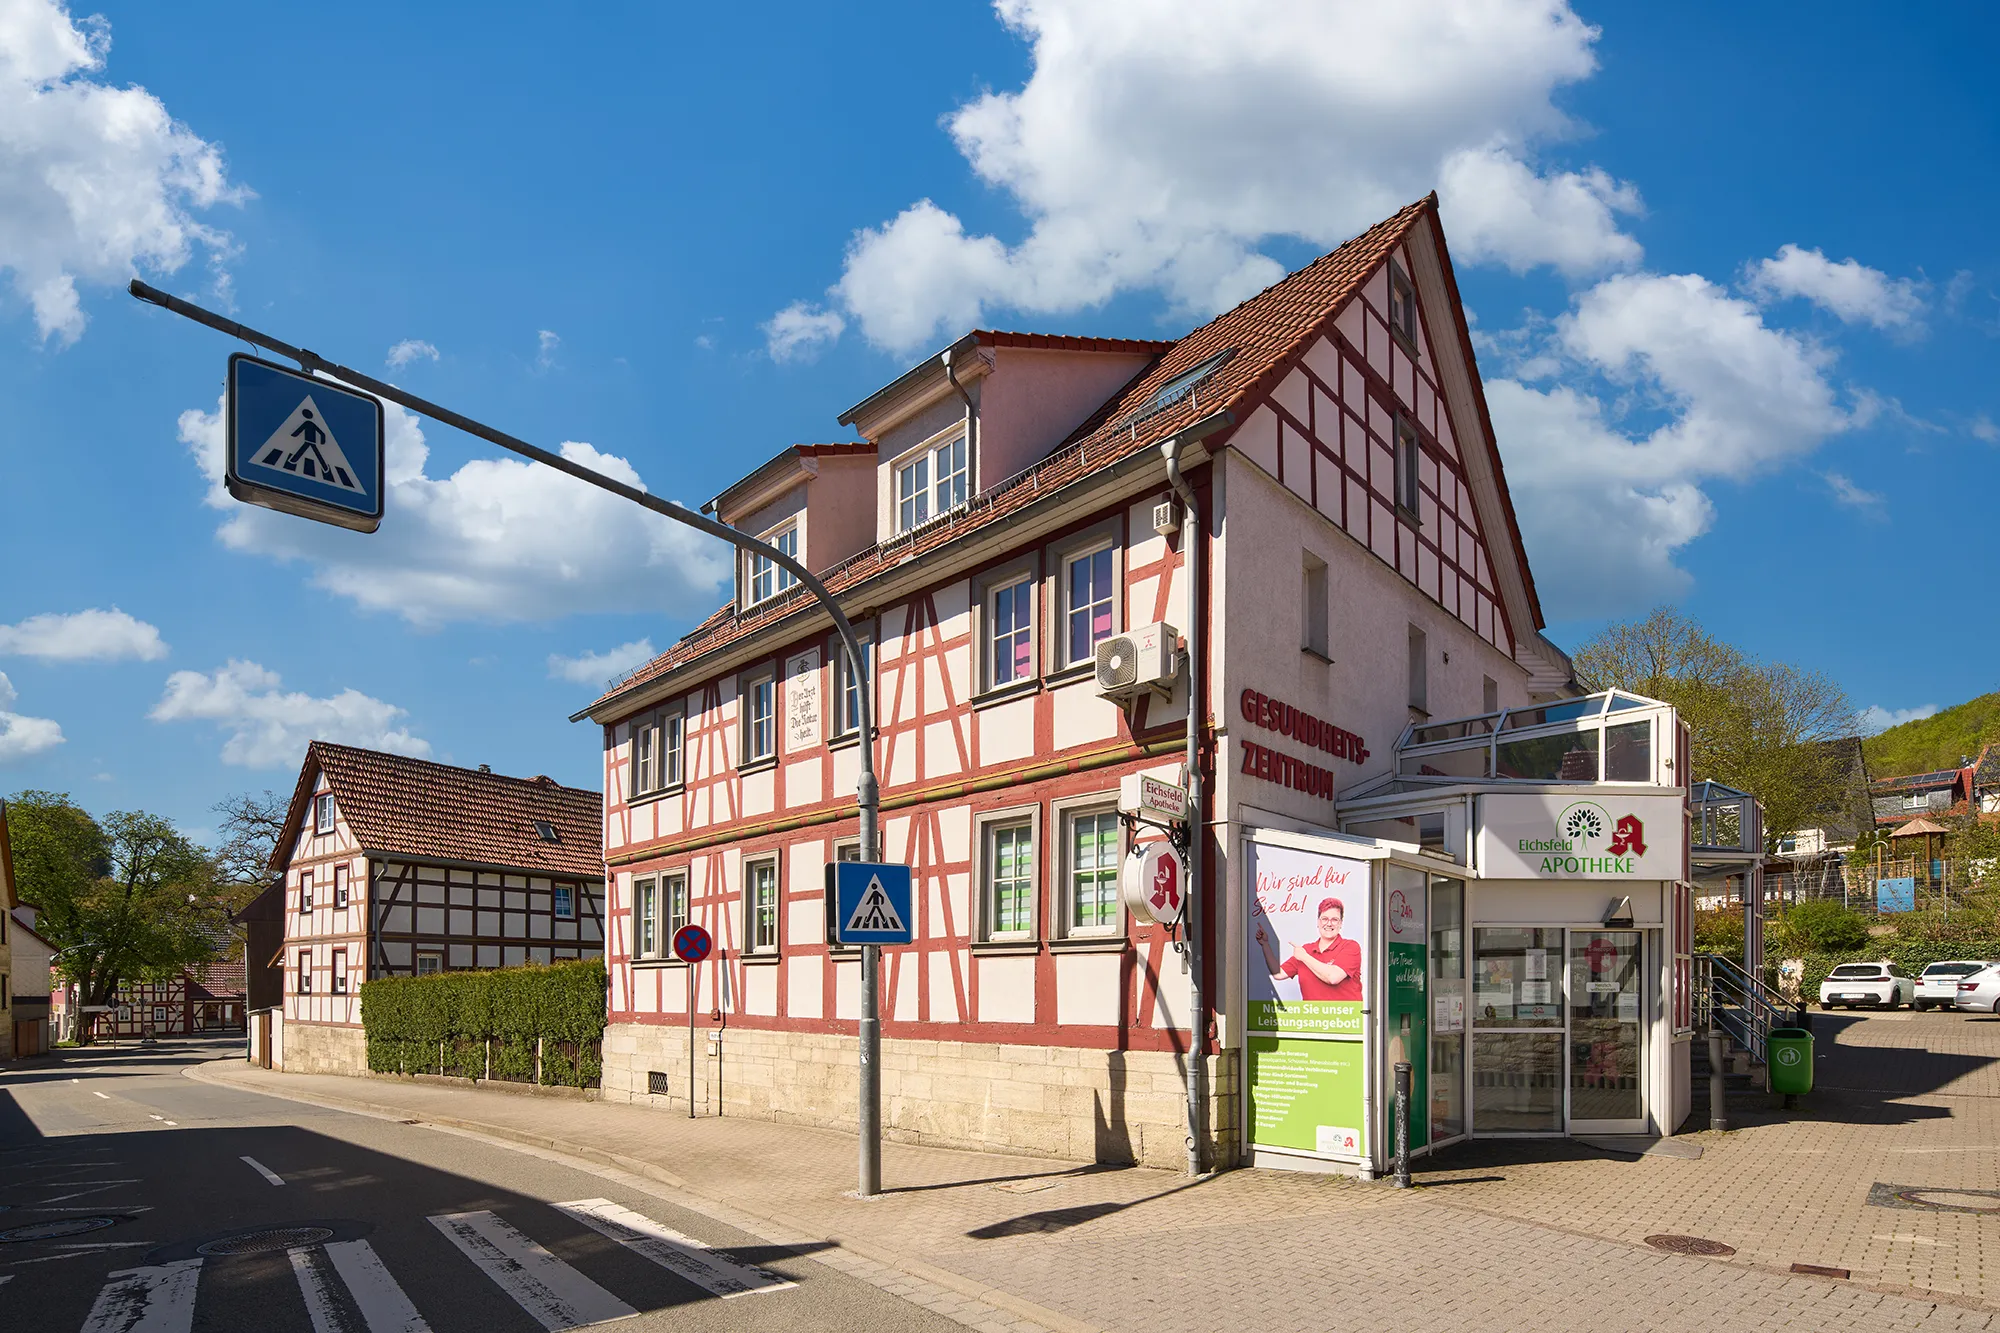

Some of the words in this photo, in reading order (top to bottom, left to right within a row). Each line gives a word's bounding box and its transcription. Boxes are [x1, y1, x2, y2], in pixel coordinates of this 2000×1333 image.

[1240, 688, 1371, 765] GESUNDHEITS-
[1240, 740, 1334, 801] ZENTRUM
[1146, 782, 1183, 803] Eichsfeld
[1150, 796, 1180, 813] Apotheke
[1518, 839, 1573, 851] Eichsfeld
[1539, 856, 1635, 873] APOTHEKE
[1255, 871, 1286, 893] Wir
[1287, 865, 1322, 892] sind
[1323, 866, 1351, 889] für
[1251, 896, 1277, 917] Sie
[1280, 893, 1308, 914] da!
[1400, 905, 1413, 919] 24h
[1262, 1003, 1300, 1014] Nutzen
[1303, 1004, 1320, 1015] Sie
[1322, 1006, 1354, 1015] unser
[1258, 1016, 1360, 1030] Leistungsangebot!
